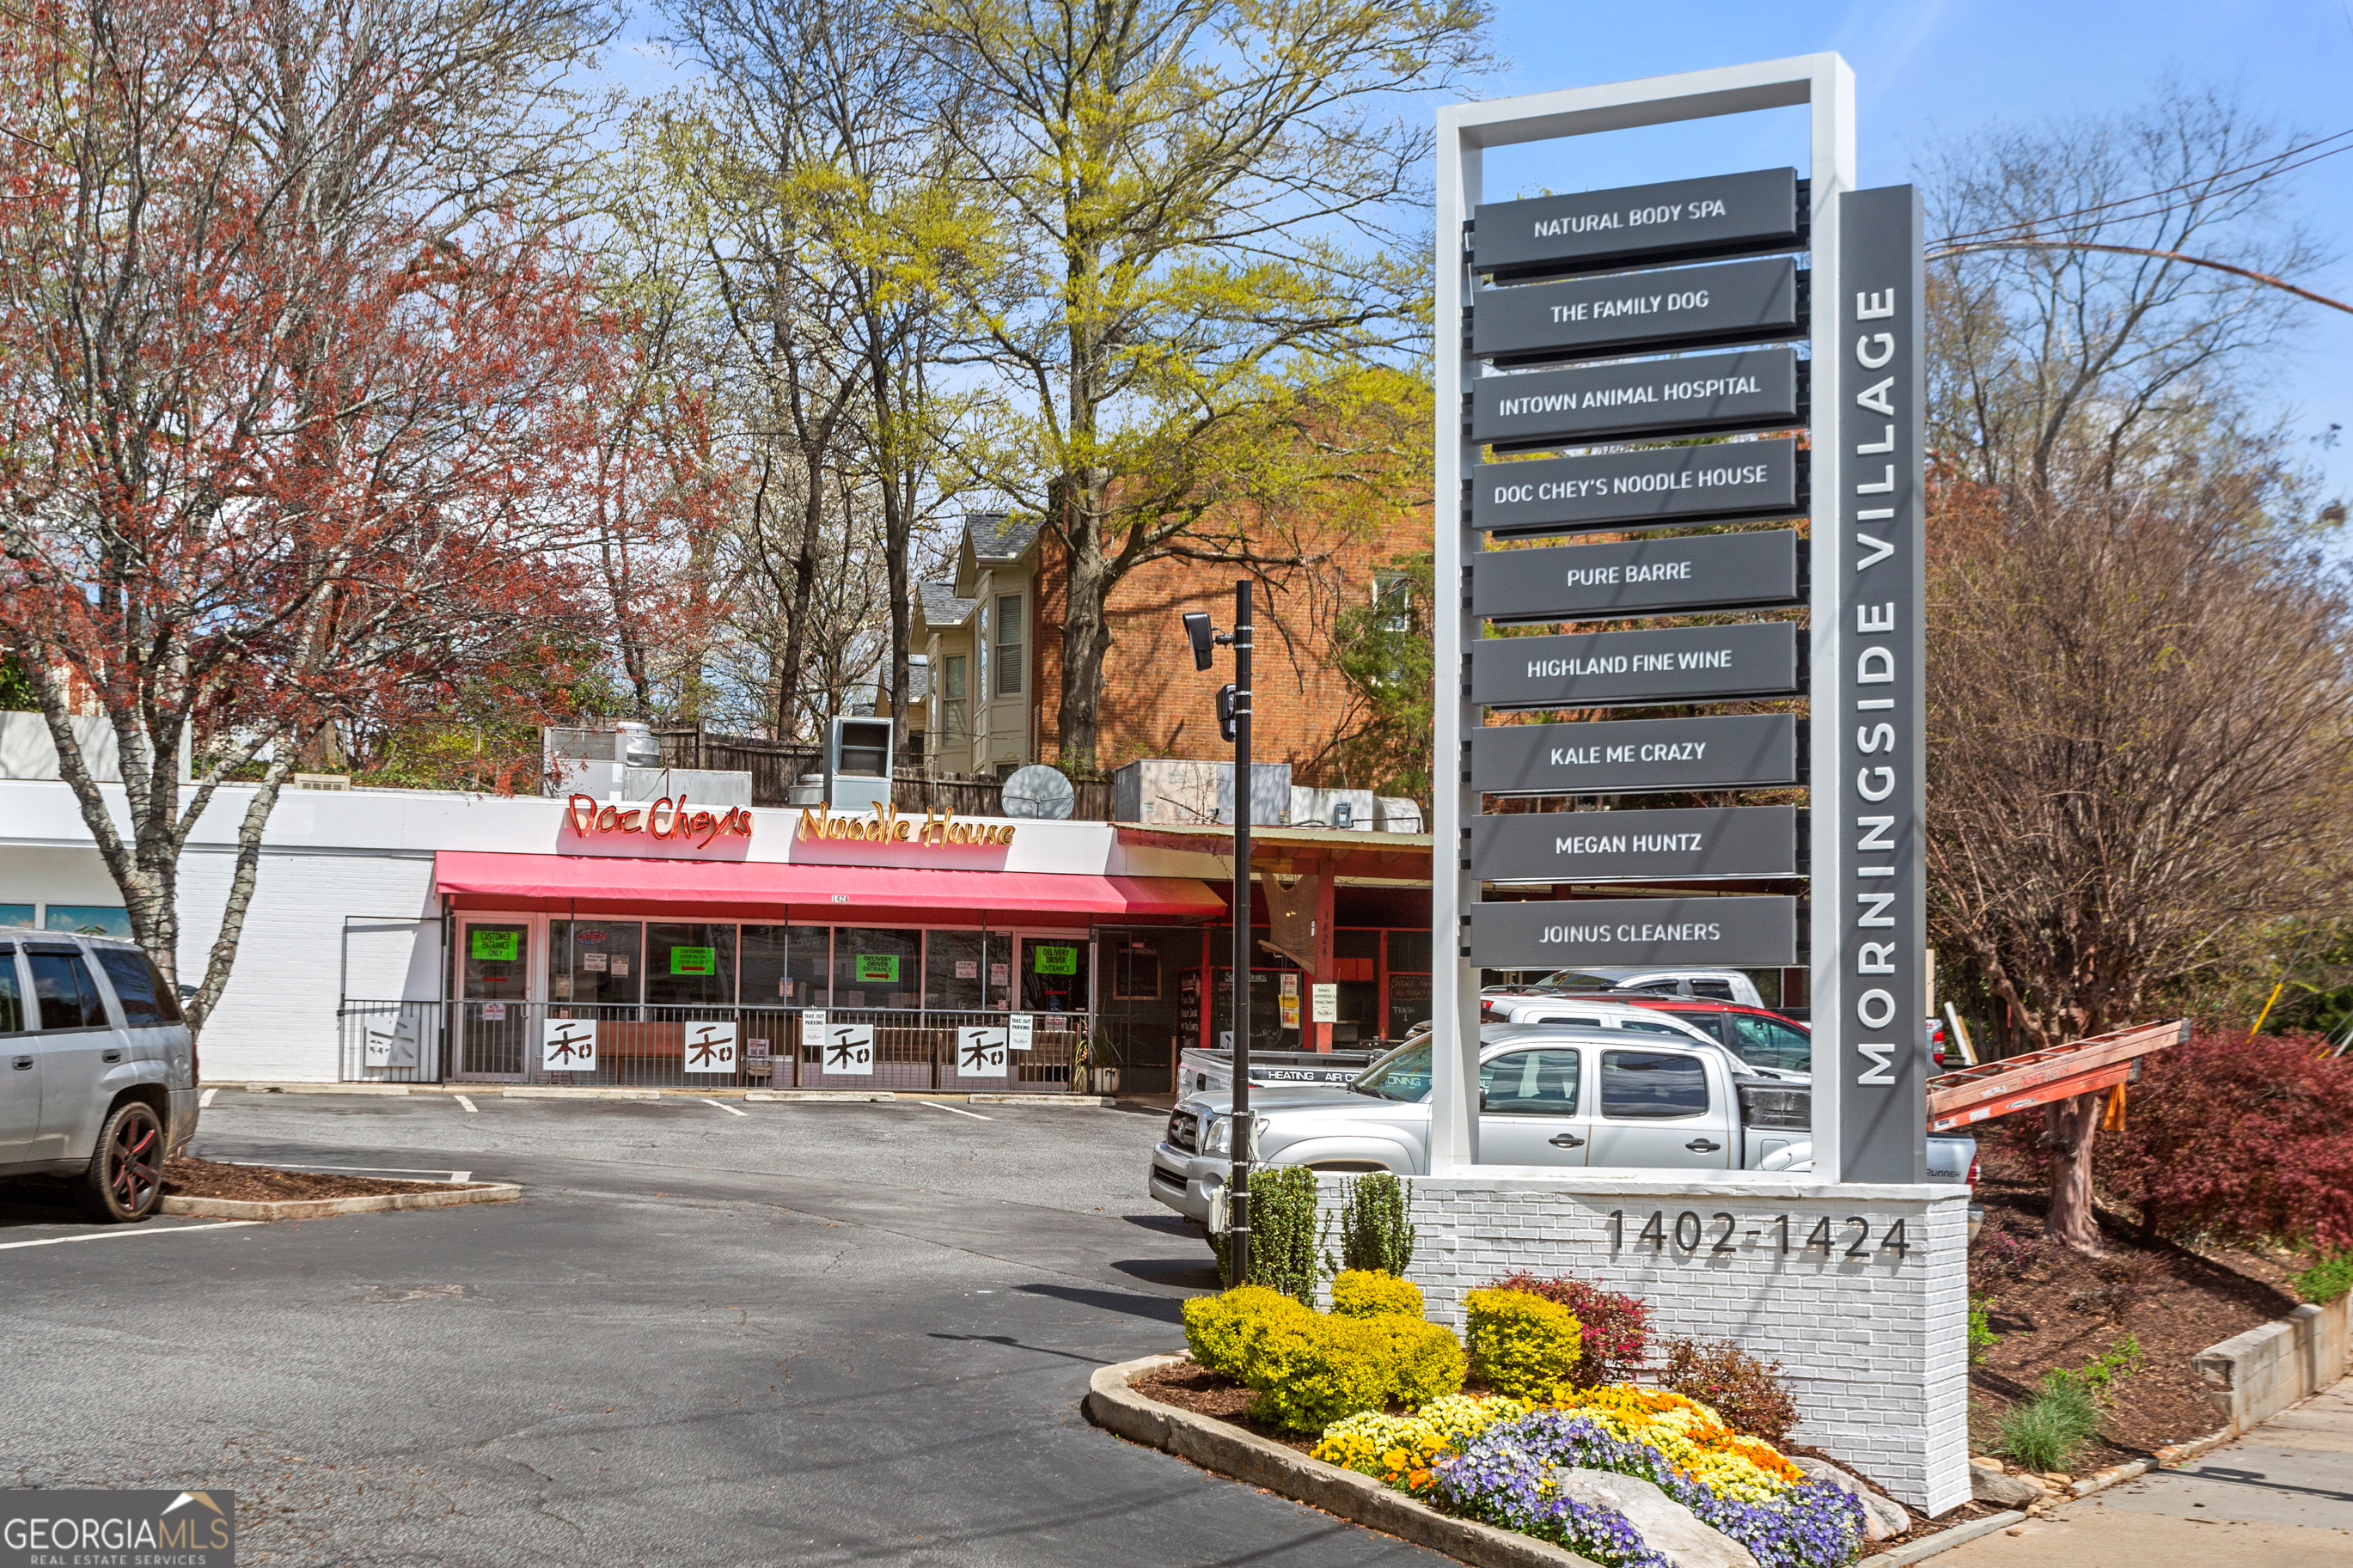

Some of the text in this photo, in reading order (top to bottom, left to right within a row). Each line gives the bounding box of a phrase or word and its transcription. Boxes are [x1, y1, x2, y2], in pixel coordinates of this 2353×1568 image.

[1535, 199, 1726, 238] NATURAL BODY SPA
[1551, 290, 1708, 323] THE FAMILY DOG
[1500, 376, 1761, 416] INTOWN ANIMAL HOSPITAL
[1856, 288, 1895, 571] VILLAGE
[1494, 465, 1767, 503] DOC CHEY'S NOODLE HOUSE
[1568, 562, 1690, 586] PURE BARRE
[1528, 650, 1732, 678] HIGHLAND FINE WINE
[1551, 742, 1706, 765] KALE ME CRAZY
[569, 794, 752, 850] Doc Chey's
[798, 801, 1016, 850] Noodle House
[1555, 833, 1702, 854] MEGAN HUNTZ
[1857, 602, 1896, 1084] MORNINGSIDE
[480, 932, 510, 941] CUSTOMER
[481, 941, 510, 949] ENTRANCE
[577, 932, 607, 941] OPEN
[1043, 948, 1070, 956] DELIVERY
[1539, 923, 1720, 943] JOINUS CLEANERS
[547, 1023, 592, 1065] 和
[688, 1026, 732, 1068] 和
[827, 1028, 870, 1070] 和
[962, 1031, 1004, 1071] 和
[1268, 1071, 1314, 1081] HEATING
[1325, 1072, 1342, 1082] AIR
[1609, 1210, 1911, 1259] 1402-1424
